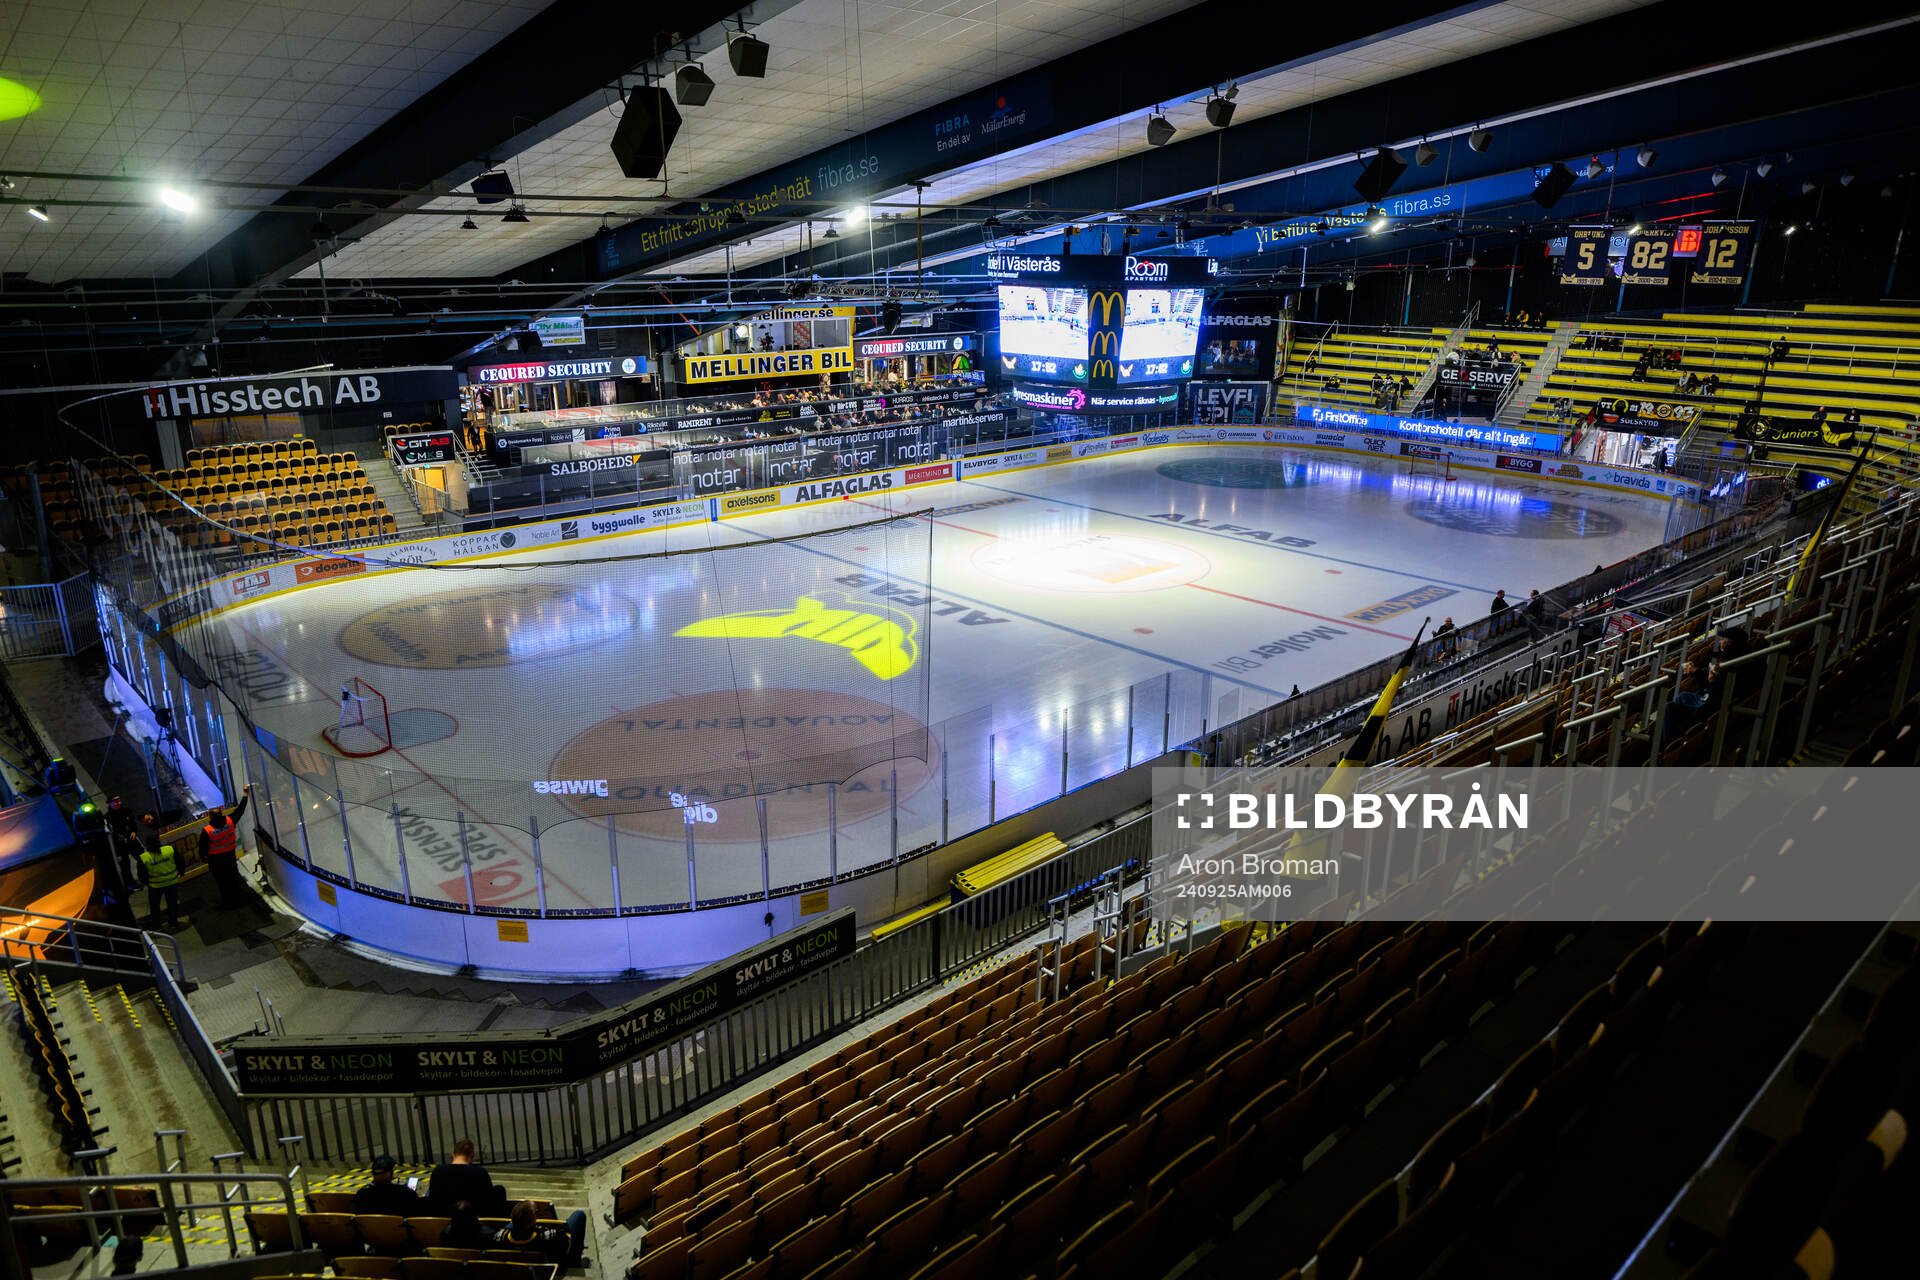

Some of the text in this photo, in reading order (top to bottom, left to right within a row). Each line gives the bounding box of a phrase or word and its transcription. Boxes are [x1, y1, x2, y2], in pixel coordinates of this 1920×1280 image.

[935, 113, 970, 136] FIBRA
[641, 228, 658, 252] Ett
[658, 220, 683, 245] fritt
[817, 155, 879, 191] fibra.se
[1255, 193, 1451, 243] Vi fibra.se
[1577, 242, 1596, 270] 5
[1631, 241, 1669, 270] 82
[1704, 238, 1738, 268] 12
[1006, 256, 1061, 272] Västerås
[1125, 256, 1168, 276] Room
[862, 340, 948, 355] CEQURED SECURITY
[479, 362, 612, 382] CEQURED SECURITY
[690, 352, 852, 379] MELLINGER BIL
[169, 376, 381, 417] Hisstech AB
[1091, 397, 1104, 406] När
[1106, 397, 1133, 406] service
[677, 418, 712, 429] RAMIRENT
[943, 412, 1004, 428] martin&servera
[1325, 411, 1368, 426] FirstOffice
[1620, 418, 1660, 428] SOLSKYDD
[407, 437, 450, 449] GITAB
[1399, 420, 1464, 438] Kontorshotell
[1465, 428, 1481, 438] där
[1503, 432, 1532, 447] ingår.
[1771, 429, 1819, 440] Juniors
[416, 451, 444, 460] MKS
[964, 458, 998, 469] ELVBYGG
[551, 456, 634, 476] SALBOHEDS
[908, 469, 943, 481] MERITMIND
[688, 464, 741, 488] notar
[1613, 472, 1650, 489] bravida
[796, 473, 893, 502] ALFAGLAS
[652, 507, 675, 519] SKYLT
[683, 503, 705, 513] NEON
[727, 494, 776, 509] axelssons
[591, 514, 646, 533] byggwalle
[1147, 513, 1317, 548] ALFAB
[453, 535, 498, 547] KOPPAR
[1212, 655, 1263, 674] Bil
[1399, 708, 1431, 751] AB
[735, 927, 839, 986] SKYLT & NEON
[736, 981, 761, 998] skyltar
[765, 964, 795, 982] bildekor
[597, 982, 719, 1048] SKYLT & NEON
[599, 1044, 628, 1061] skyltar
[634, 1024, 669, 1044] bildekor
[246, 1053, 393, 1071] SKYLT & NEON
[417, 1047, 565, 1067] SKYLT & NEON
[249, 1075, 281, 1085] skyltar
[289, 1073, 330, 1083] bildekor
[420, 1070, 452, 1081] skyltar
[461, 1068, 501, 1079] bildekor
